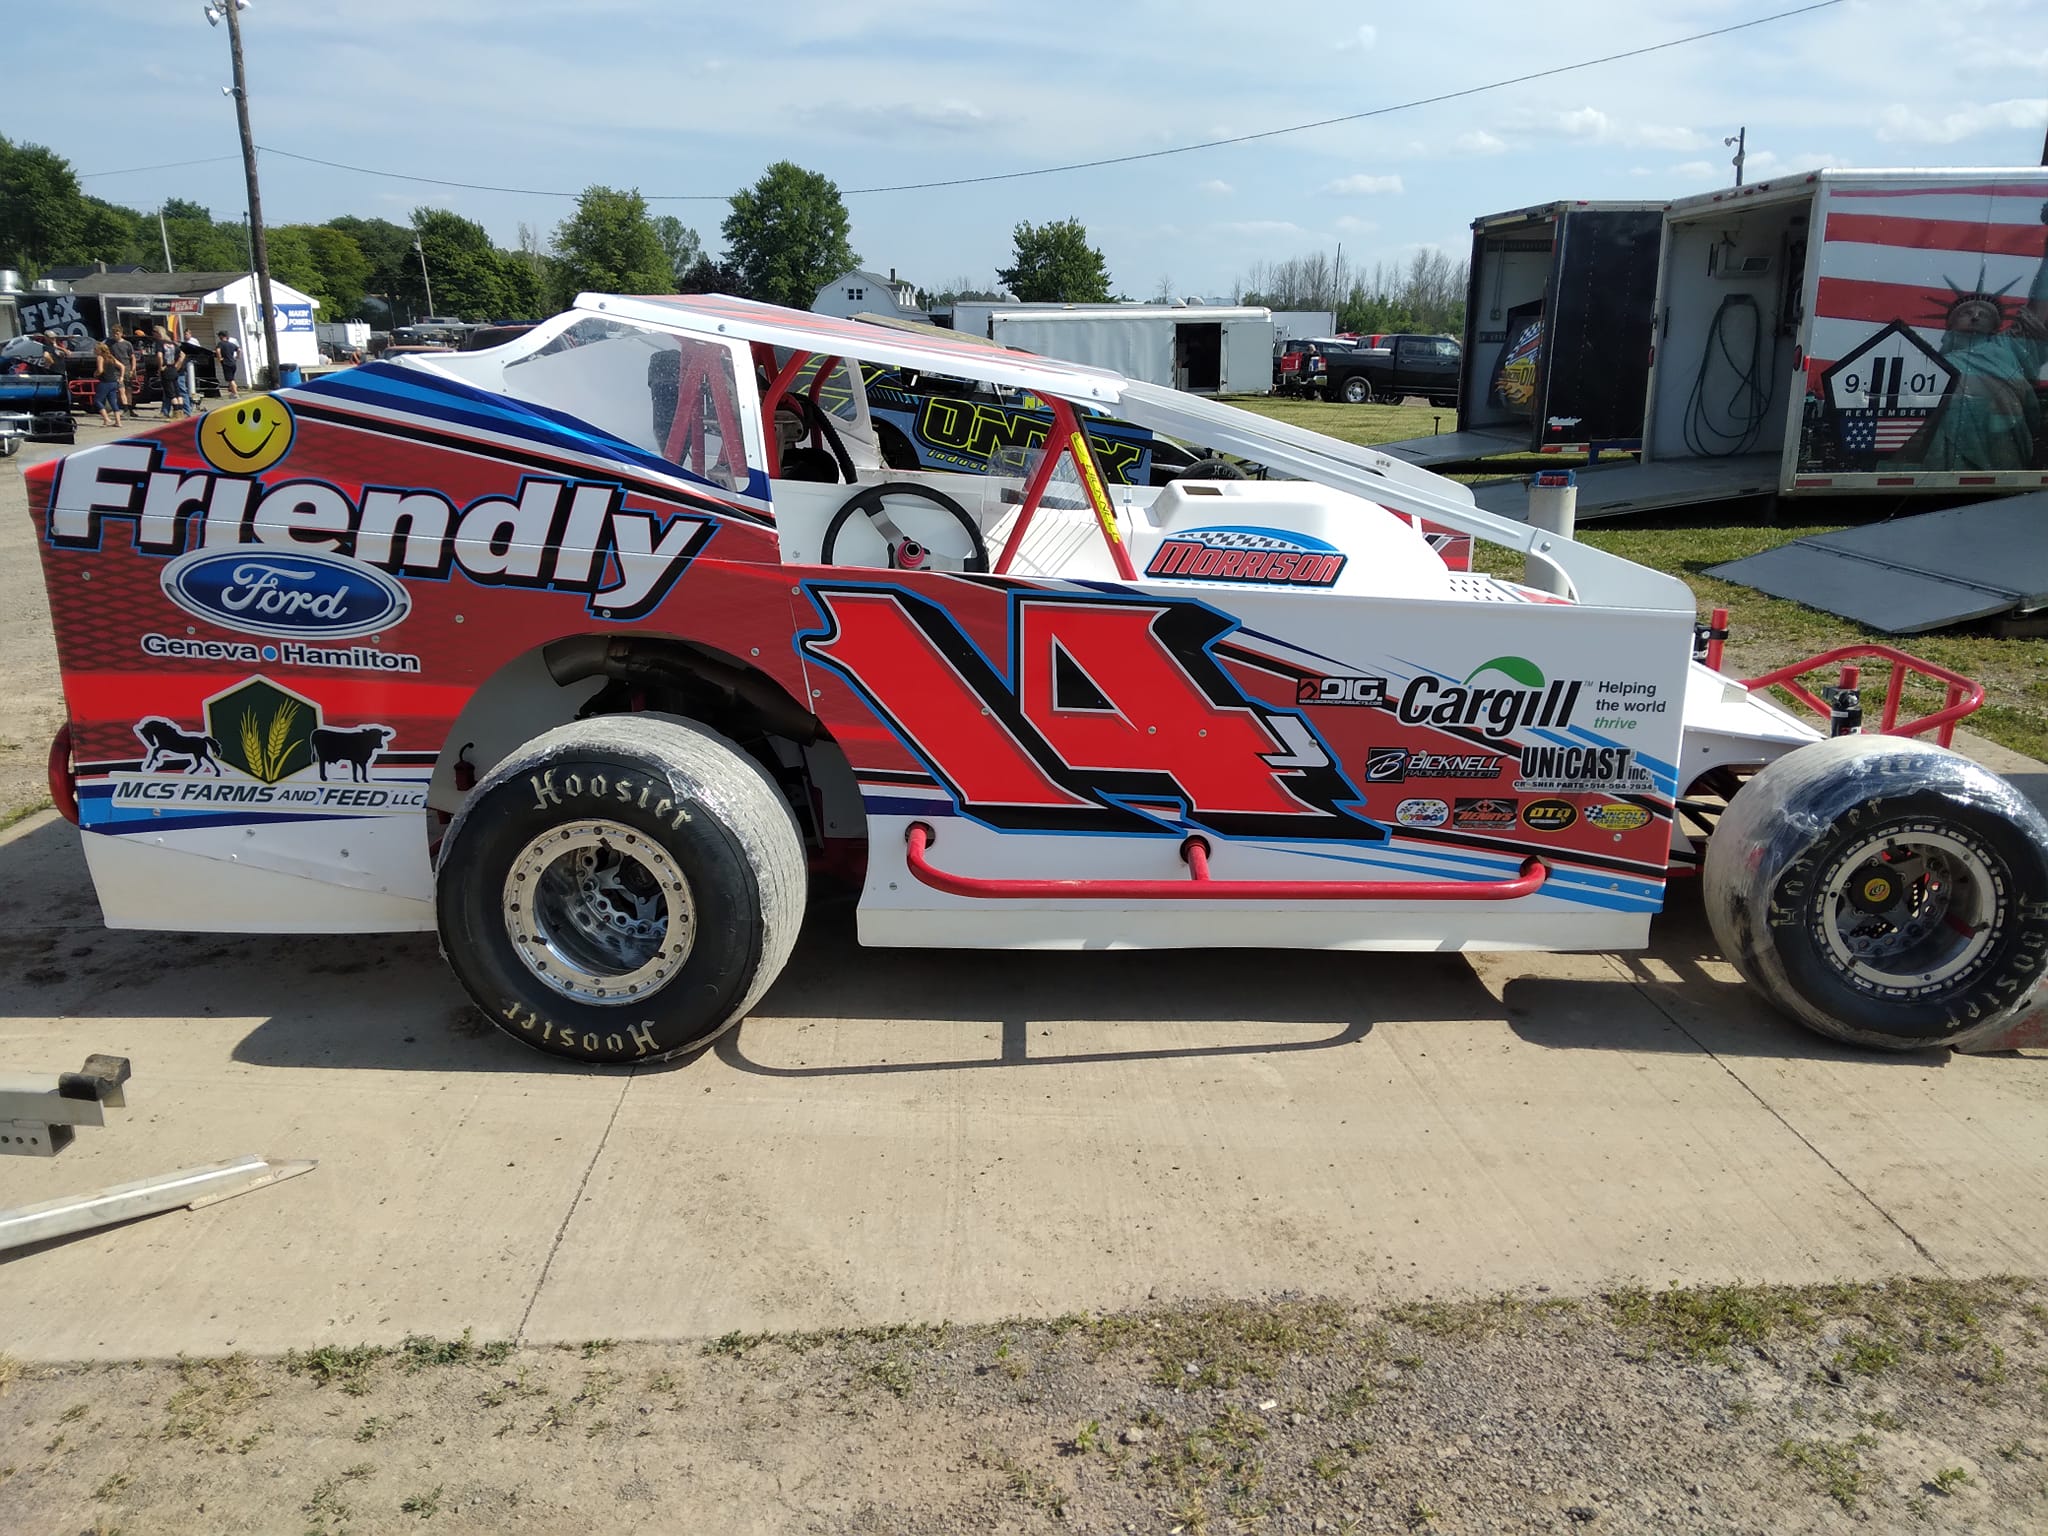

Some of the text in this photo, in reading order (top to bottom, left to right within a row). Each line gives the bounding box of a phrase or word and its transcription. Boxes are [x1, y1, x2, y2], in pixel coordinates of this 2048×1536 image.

[1845, 409, 1928, 418] REMEMBER
[51, 444, 710, 614] Friendly
[1147, 540, 1345, 584] MORRISON
[220, 560, 349, 620] Ford
[142, 634, 421, 672] Geneva Hamilton
[1598, 680, 1657, 698] Helping
[1400, 674, 1582, 738] Cargill
[1596, 699, 1666, 713] the world
[1593, 716, 1637, 730] thrive
[1408, 755, 1500, 770] BICKNELL
[116, 781, 424, 808] MCS FARMS AND FEED LLC
[529, 768, 693, 832] Hoosier
[1514, 780, 1555, 789] CRSHER
[502, 1000, 660, 1056] Hoosier
